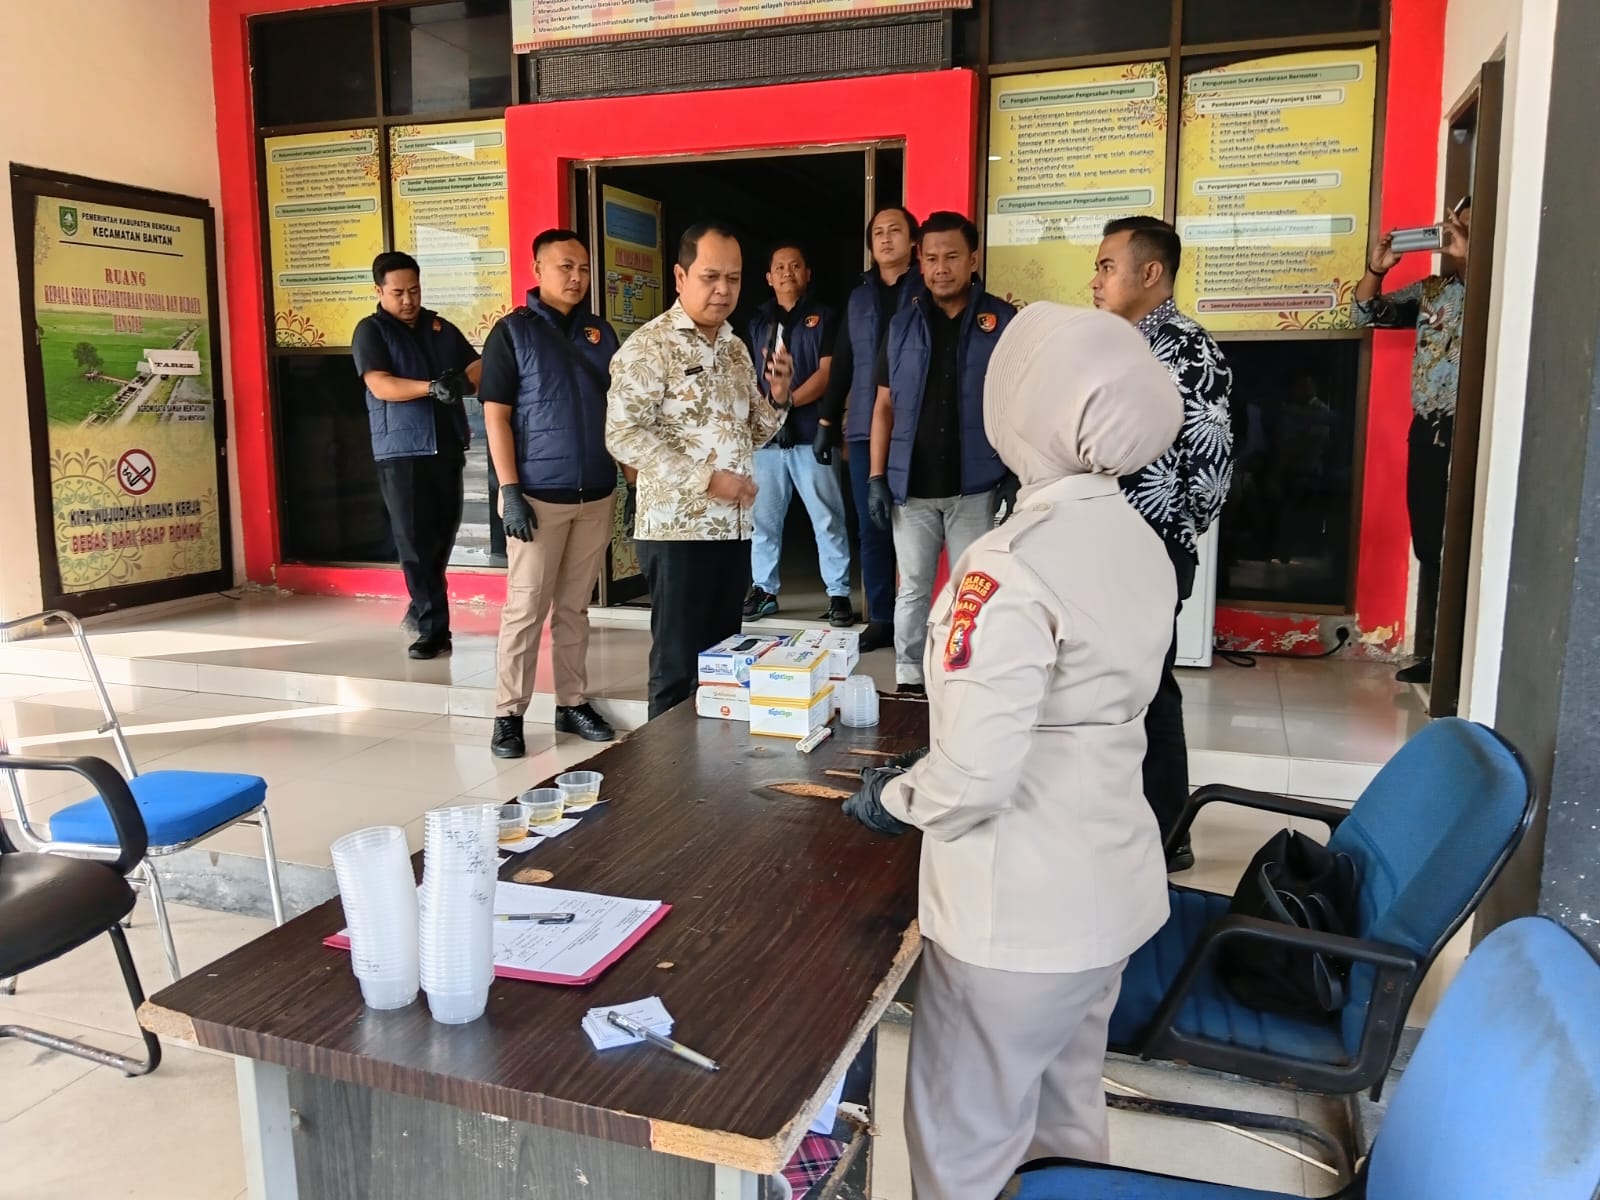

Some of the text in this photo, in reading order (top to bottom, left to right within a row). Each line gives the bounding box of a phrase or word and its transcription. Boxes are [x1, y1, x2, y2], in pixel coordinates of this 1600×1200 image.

[82, 212, 180, 232] PEMERINTAH KABUPATEN BENGKALIS
[93, 226, 172, 246] KECAMATAN BANTAN
[105, 268, 146, 287] RUANG
[44, 284, 70, 304] KEPALA
[72, 287, 92, 306] SEKSI
[145, 292, 166, 312] SOSIAL
[167, 295, 179, 312] DAN
[180, 296, 202, 314] BUDAYA
[114, 314, 127, 333] DAN
[70, 499, 202, 528] KITA WUJUDKAN RUANG KERJA
[72, 522, 202, 555] BEBAS DARI ASAP ROKOK
[769, 672, 794, 681] RightSign
[768, 708, 793, 718] RightSign
